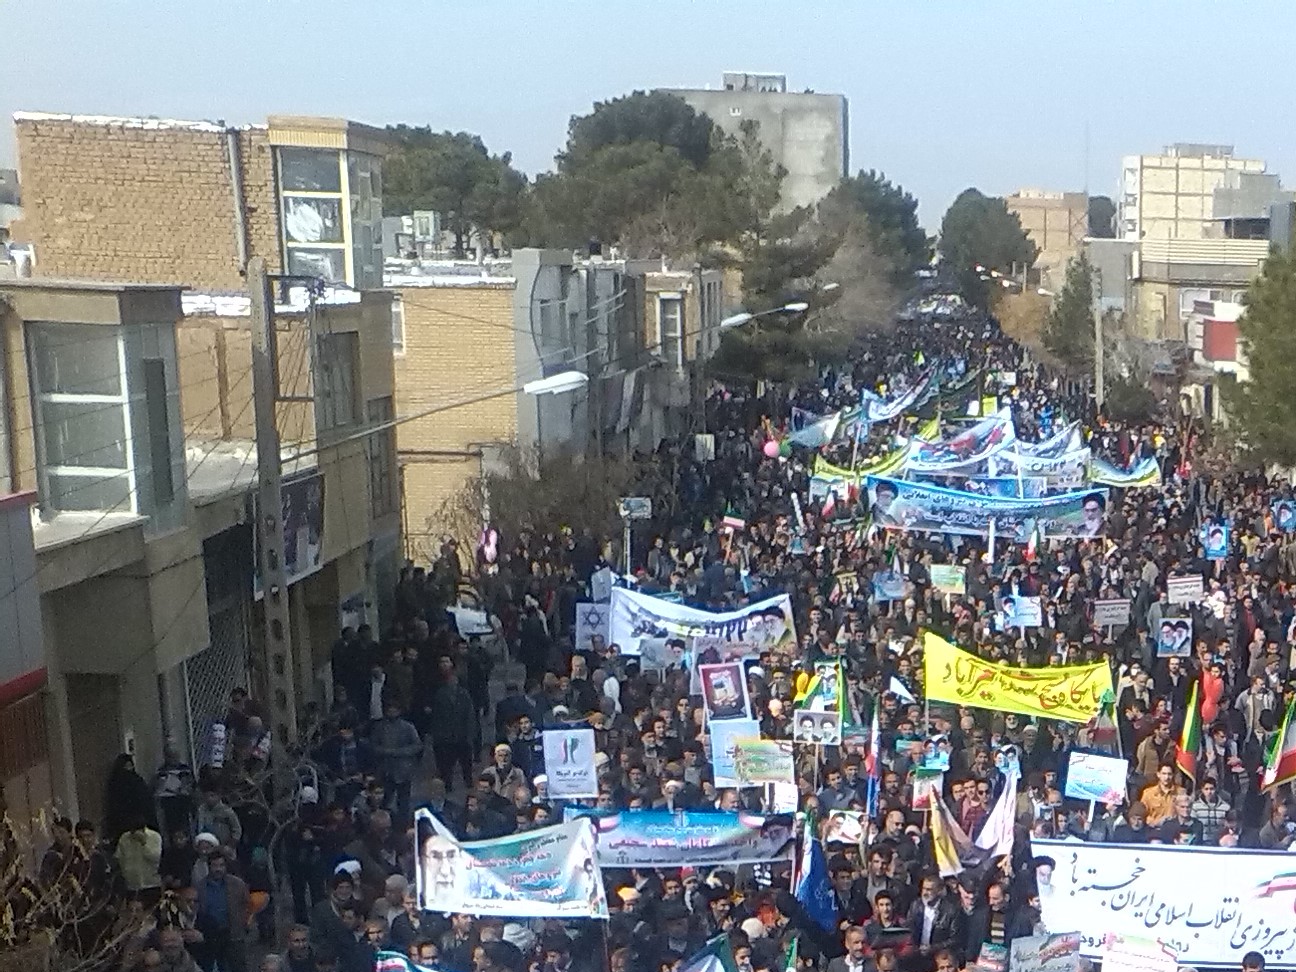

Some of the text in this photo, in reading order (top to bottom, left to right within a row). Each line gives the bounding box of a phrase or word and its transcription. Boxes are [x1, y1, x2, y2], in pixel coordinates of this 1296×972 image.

[1070, 852, 1078, 896] باد
[1078, 858, 1146, 907] خجسته
[1111, 890, 1155, 918] ایران
[1145, 902, 1193, 927] اسلامی
[1186, 897, 1242, 939] انقلاب
[1230, 918, 1288, 960] پیروزی
